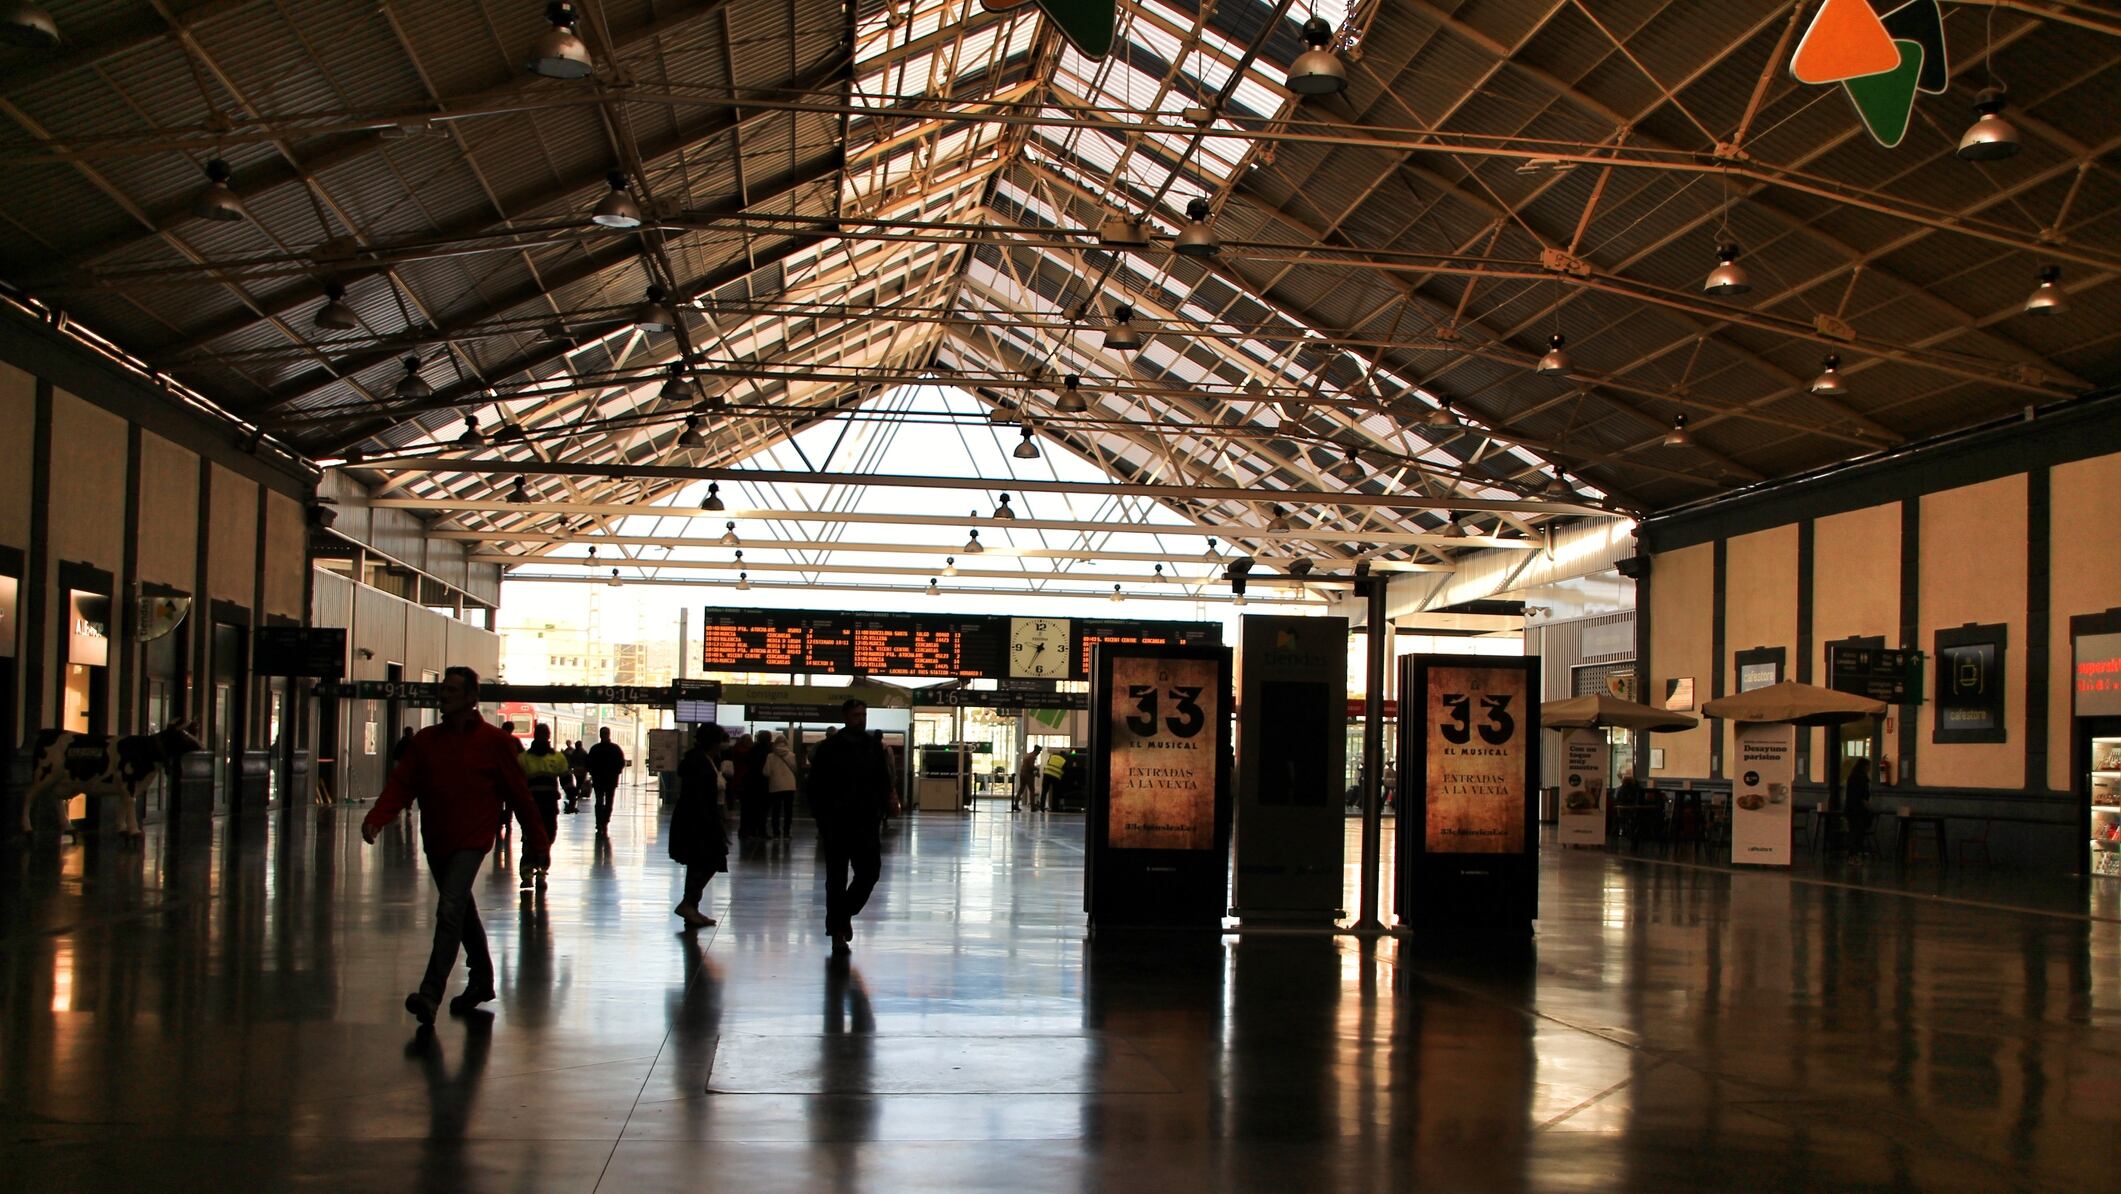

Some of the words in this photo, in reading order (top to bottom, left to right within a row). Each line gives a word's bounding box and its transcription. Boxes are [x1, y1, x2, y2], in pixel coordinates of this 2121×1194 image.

[1036, 623, 1047, 632] 12
[1015, 644, 1023, 652] 9
[1057, 645, 1065, 653] 3
[1264, 651, 1330, 667] tiendas
[1036, 666, 1043, 674] 6
[1744, 670, 1775, 682] cafestore
[384, 683, 419, 699] 9:14
[605, 687, 640, 702] 9:14
[746, 689, 788, 701] Consigna
[1126, 684, 1205, 738] 33
[1950, 708, 1987, 721] cafestore
[1440, 693, 1515, 745] 33
[1129, 740, 1141, 749] EL
[1147, 741, 1198, 750] MUSICAL
[1744, 745, 1788, 753] Desayuno
[1461, 748, 1509, 757] MUSICAL
[1743, 753, 1781, 761] parisino
[1128, 767, 1194, 778] ENTRADAS
[1443, 773, 1505, 783] ENTRADAS
[1127, 780, 1135, 789] A
[1139, 780, 1153, 789] LA
[1158, 780, 1198, 790] VENTA
[1441, 786, 1450, 795] A
[1453, 786, 1467, 795] LA
[1471, 785, 1509, 795] VENTA
